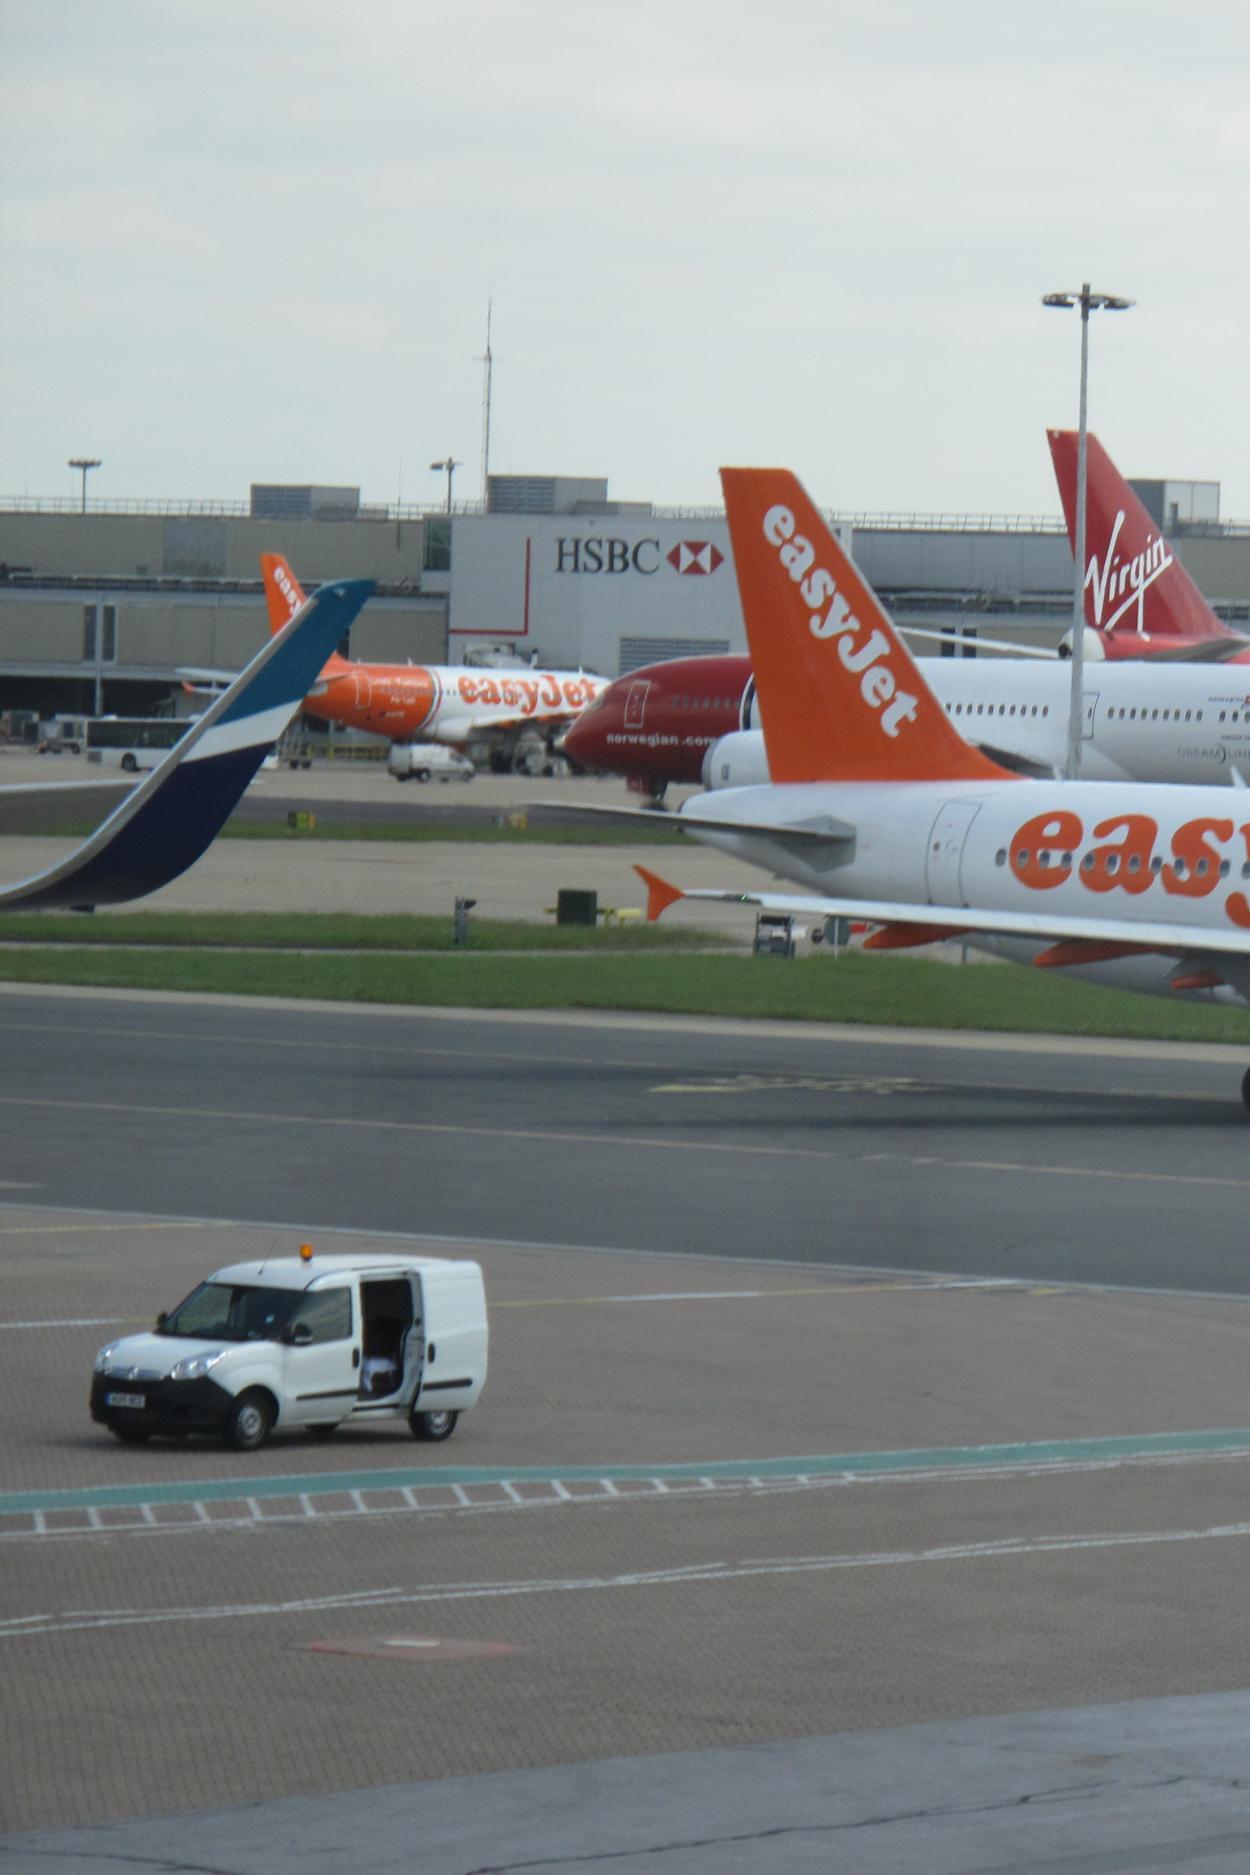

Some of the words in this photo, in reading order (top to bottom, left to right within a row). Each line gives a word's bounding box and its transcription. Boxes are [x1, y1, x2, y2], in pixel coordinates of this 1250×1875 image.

[555, 537, 661, 575] HSBC
[1083, 508, 1174, 643] Virgin
[762, 504, 919, 738] easyJet
[457, 673, 600, 717] easyJet
